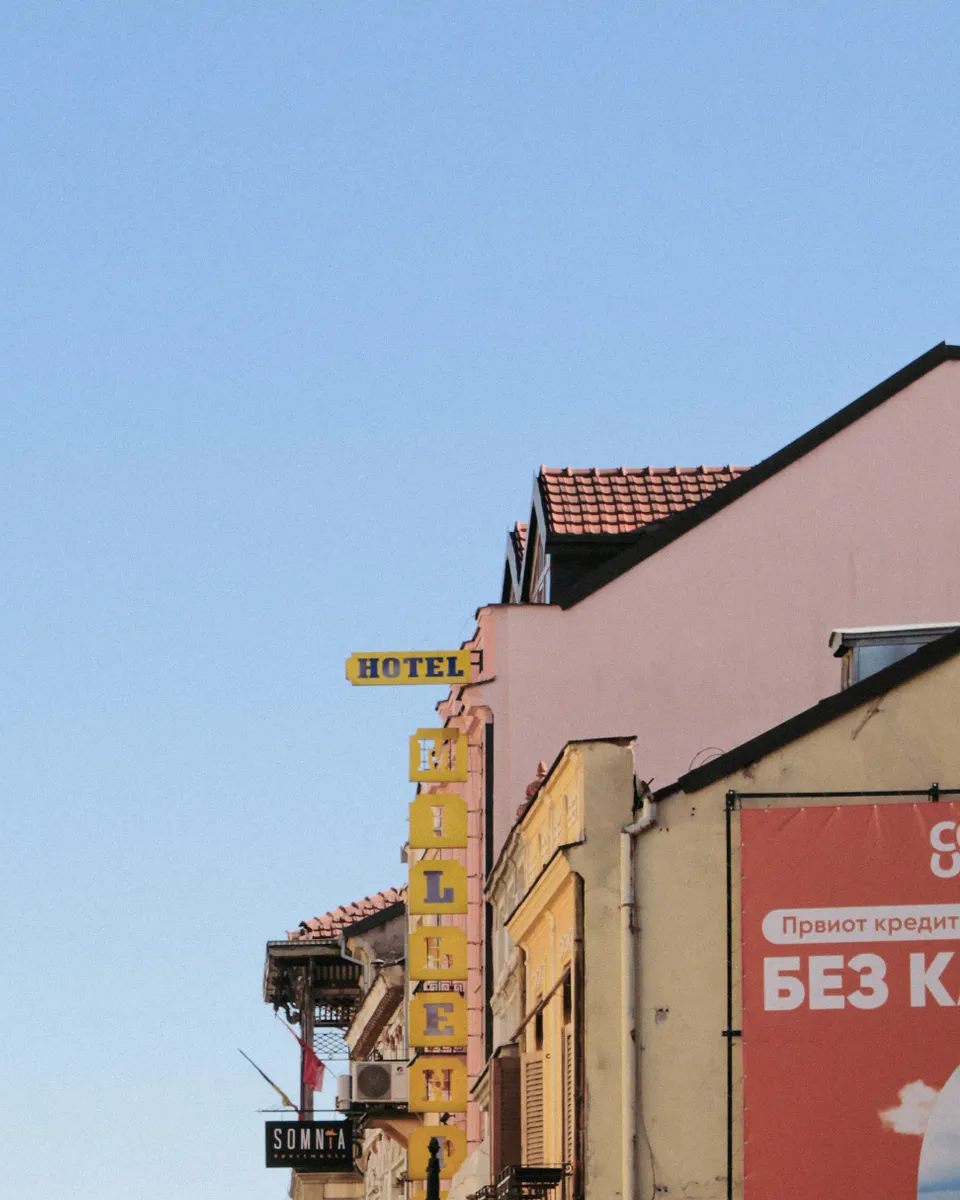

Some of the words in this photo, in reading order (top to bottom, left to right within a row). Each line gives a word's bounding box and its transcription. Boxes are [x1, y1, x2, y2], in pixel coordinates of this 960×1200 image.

[357, 655, 464, 679] HOTEL
[782, 916, 868, 939] Првиот
[874, 915, 960, 936] кредит
[763, 953, 889, 1011] БЕЗ
[909, 952, 960, 1008] К
